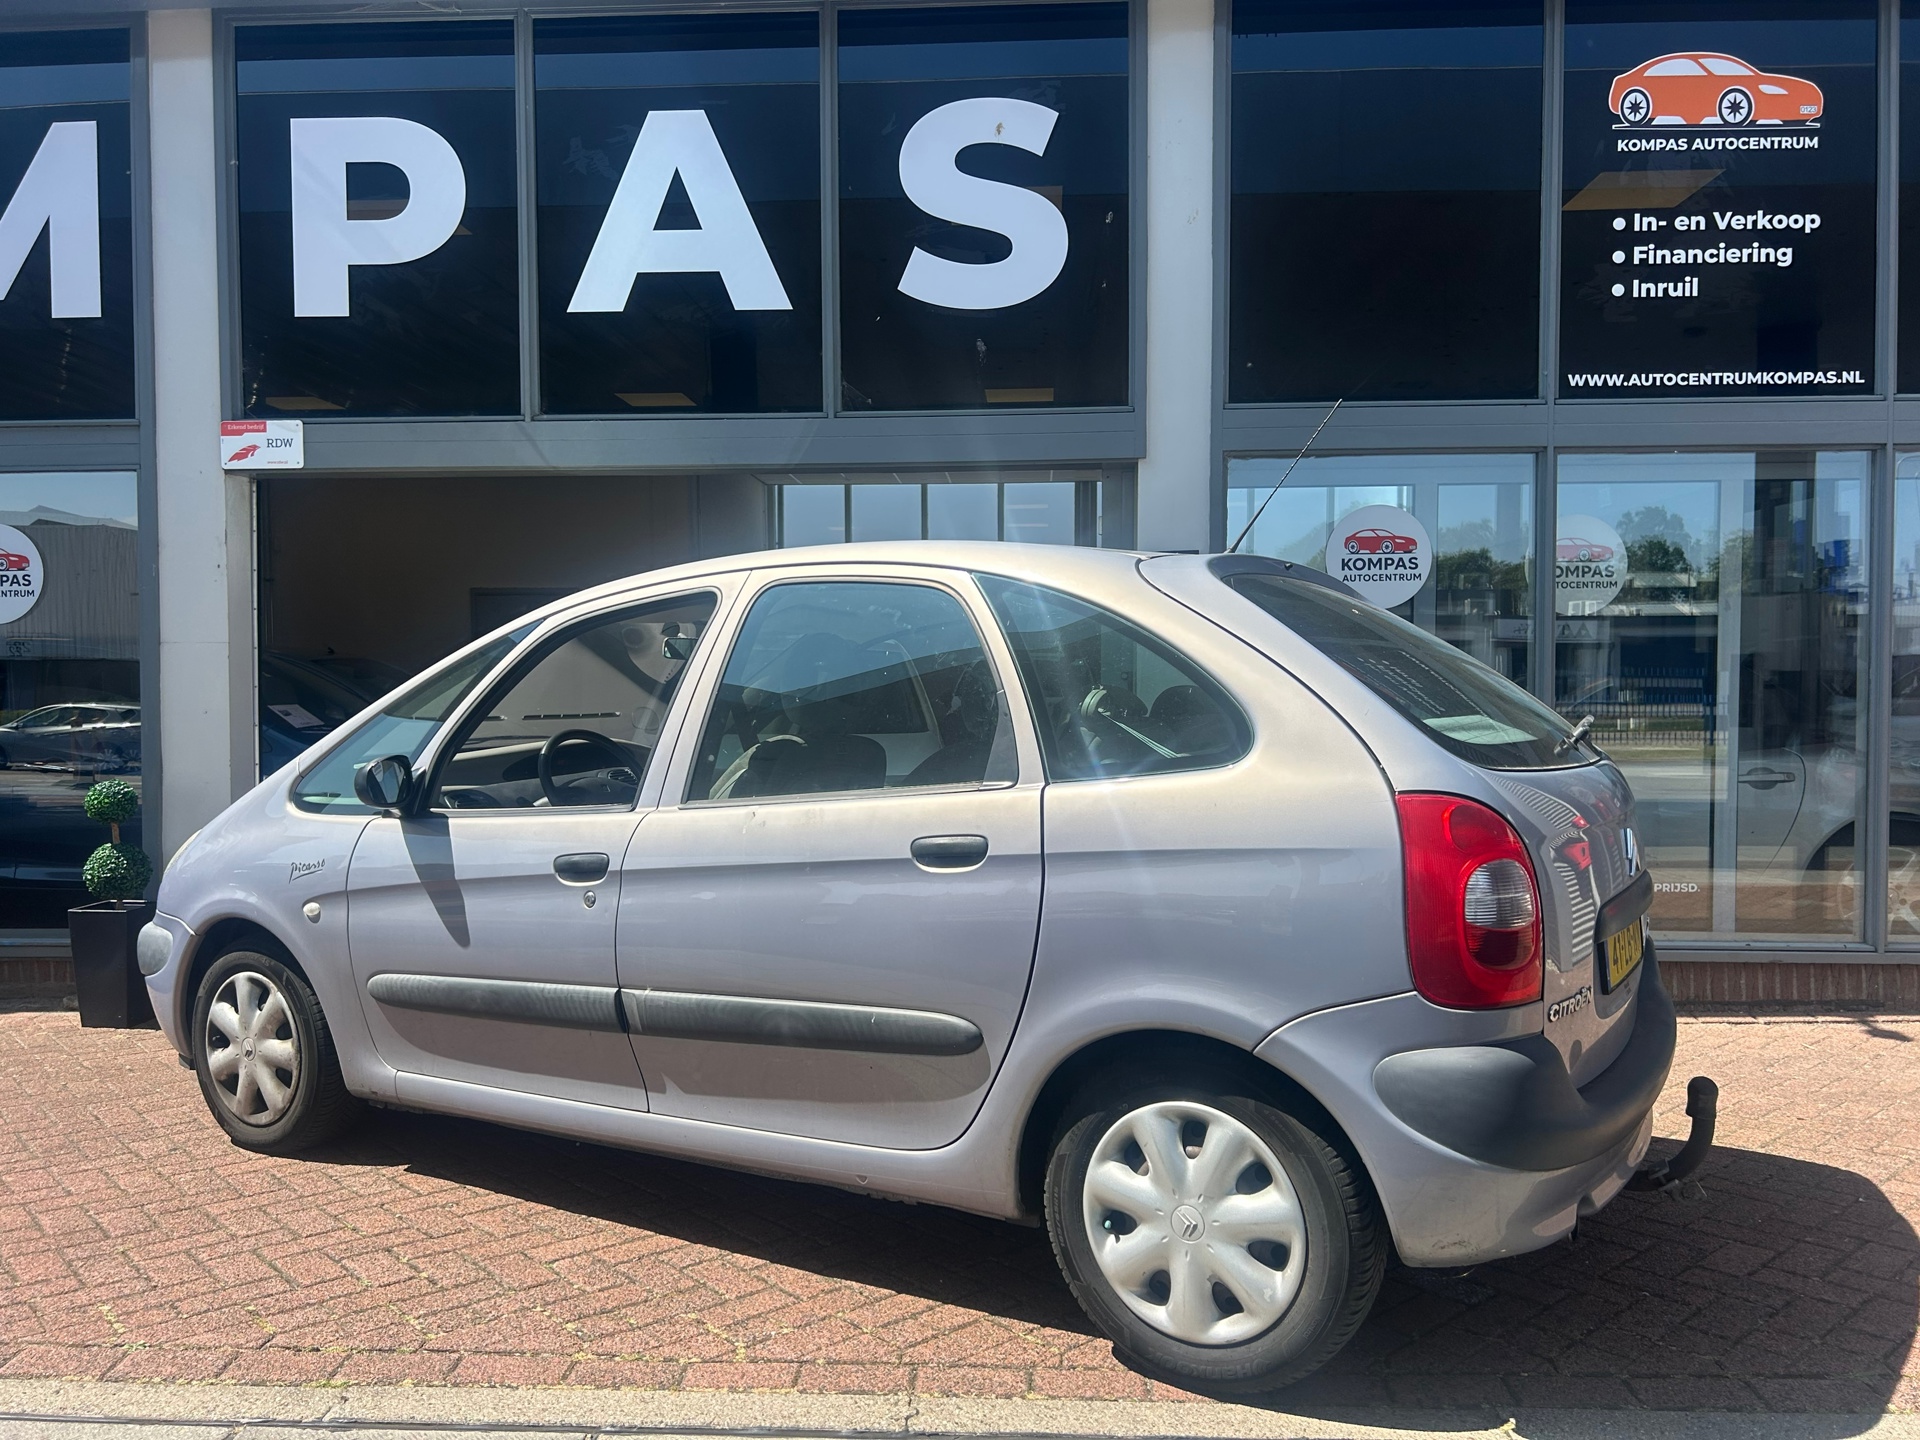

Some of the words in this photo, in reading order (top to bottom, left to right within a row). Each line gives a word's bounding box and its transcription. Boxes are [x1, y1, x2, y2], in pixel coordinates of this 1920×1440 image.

[1616, 138, 1688, 152] KOMPAS
[1691, 136, 1819, 150] AUTOCENTRUM
[1633, 213, 1667, 231] In-
[1674, 215, 1706, 231] en
[1713, 210, 1821, 233] Verkoop
[1633, 242, 1793, 267] Financiering
[1632, 276, 1699, 298] Inruil
[1567, 370, 1865, 387] WWW.AUTOCENTRUMKOMPAS.NL
[266, 438, 294, 448] RDW
[1340, 556, 1419, 571] KOMPAS
[1341, 572, 1422, 583] AUTOCENTRUM
[1547, 985, 1592, 1023] CITROËN
